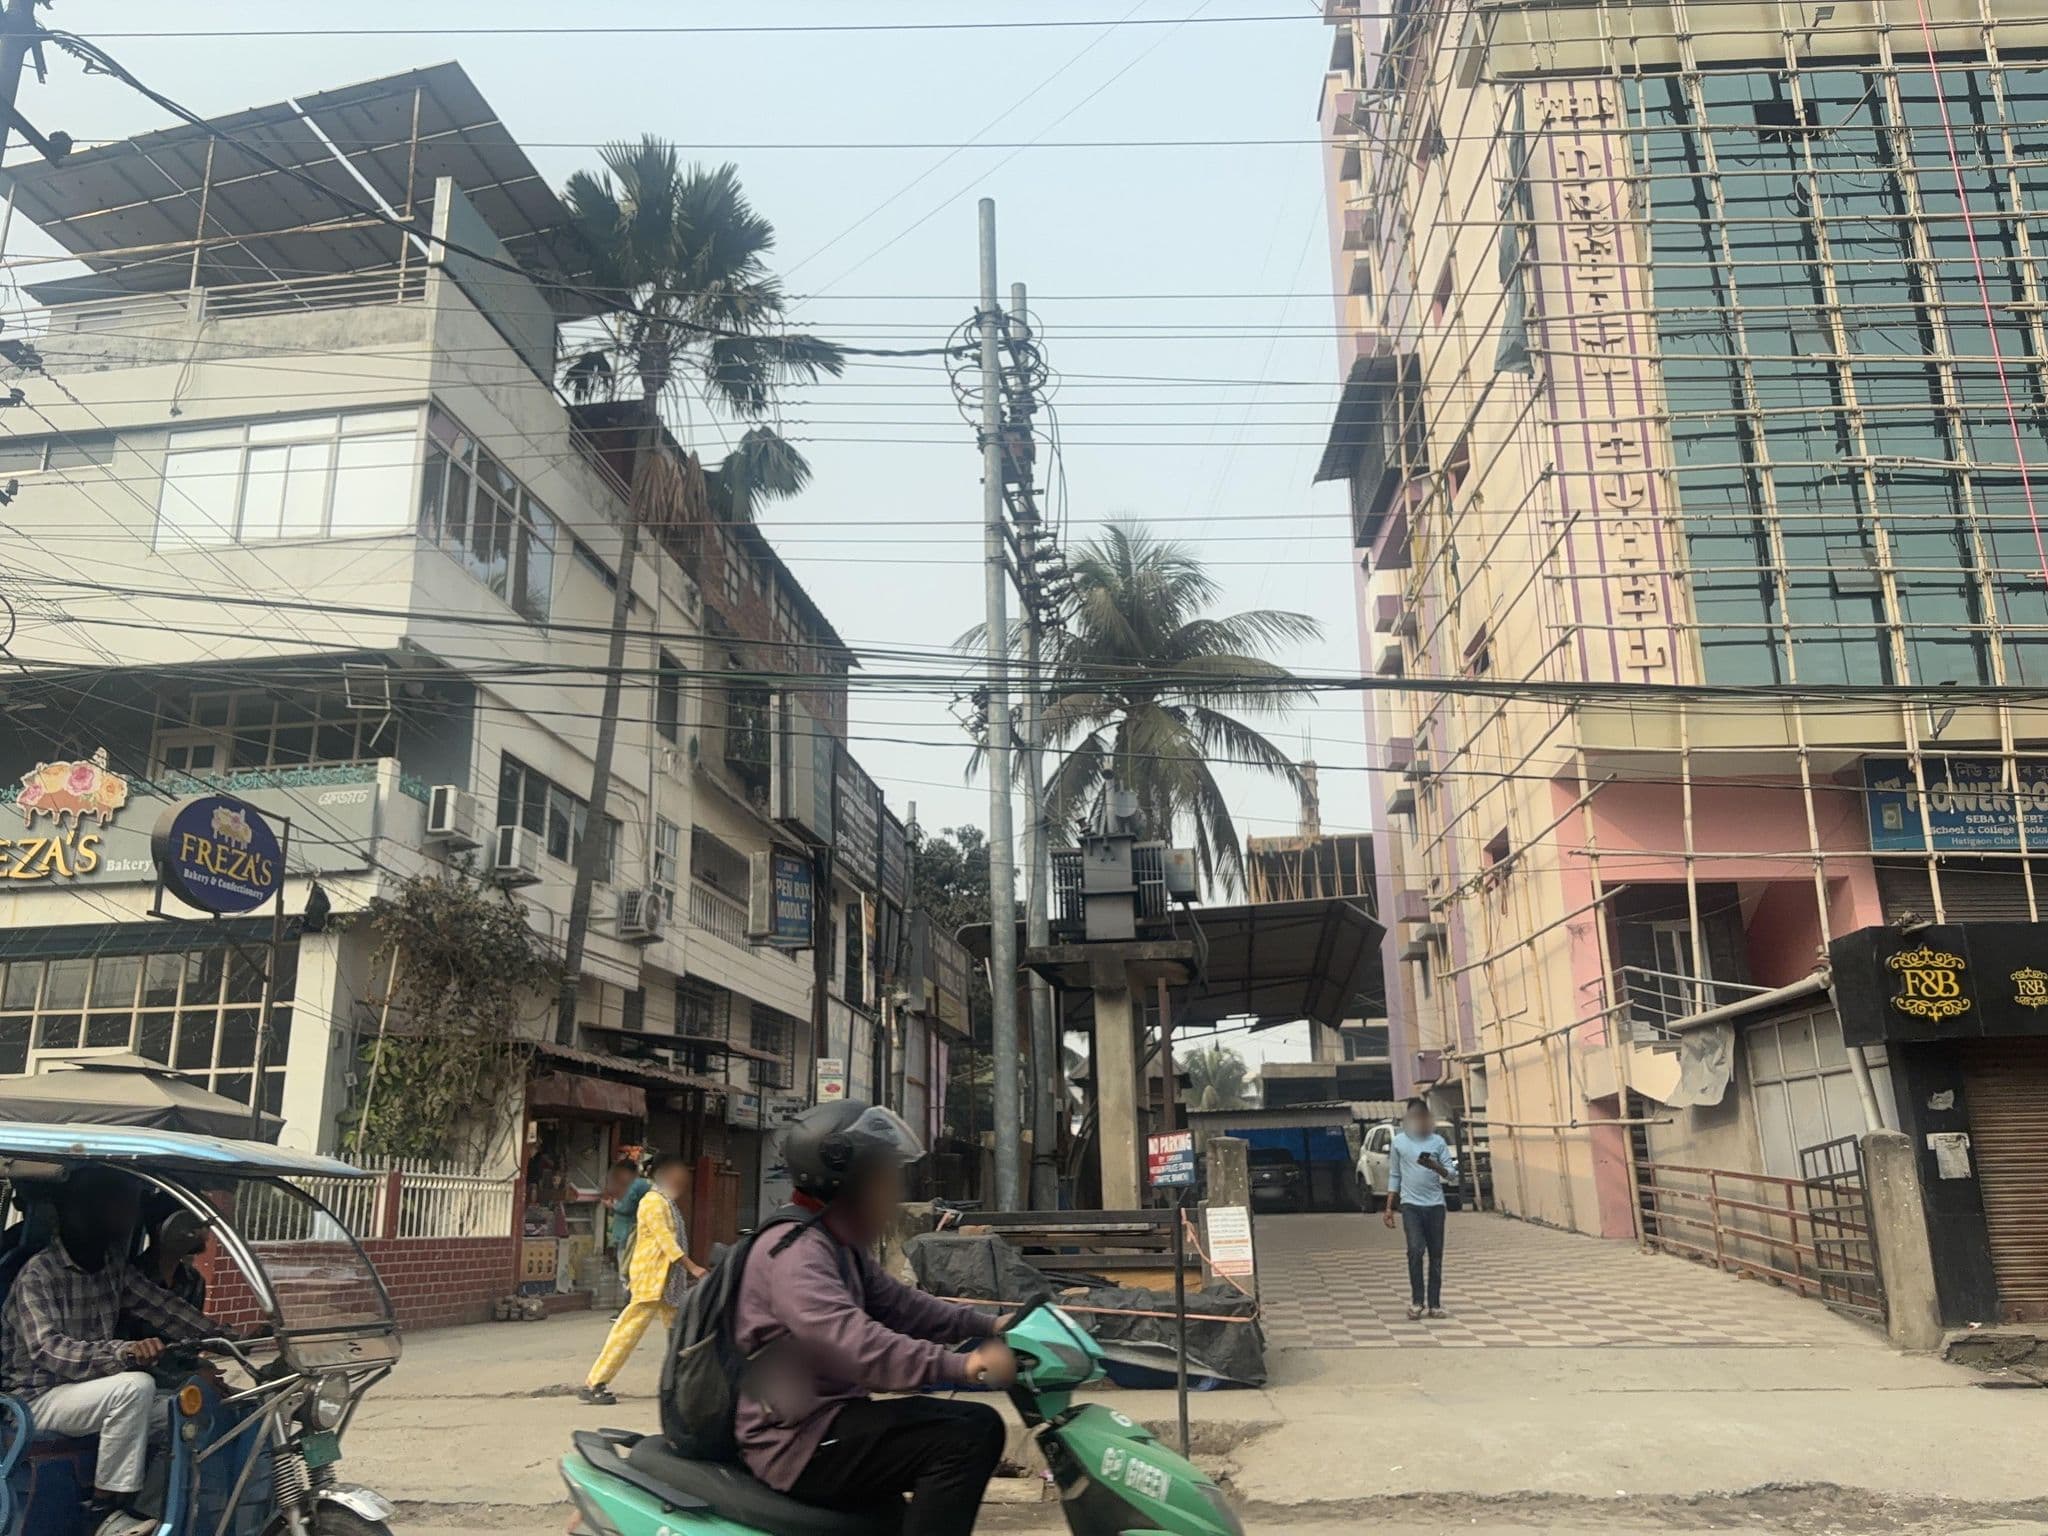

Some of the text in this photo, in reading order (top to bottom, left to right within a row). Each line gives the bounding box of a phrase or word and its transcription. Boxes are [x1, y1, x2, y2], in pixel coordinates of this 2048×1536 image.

[1557, 146, 1629, 376] DREAM
[1595, 416, 1666, 669] HOTEL
[1965, 814, 1995, 824] SEBA
[105, 858, 153, 872] Bakery
[179, 832, 273, 887] FREZA'S
[183, 868, 210, 886] Bakery
[1902, 969, 1960, 997] F&B
[2017, 979, 2046, 995] F&B
